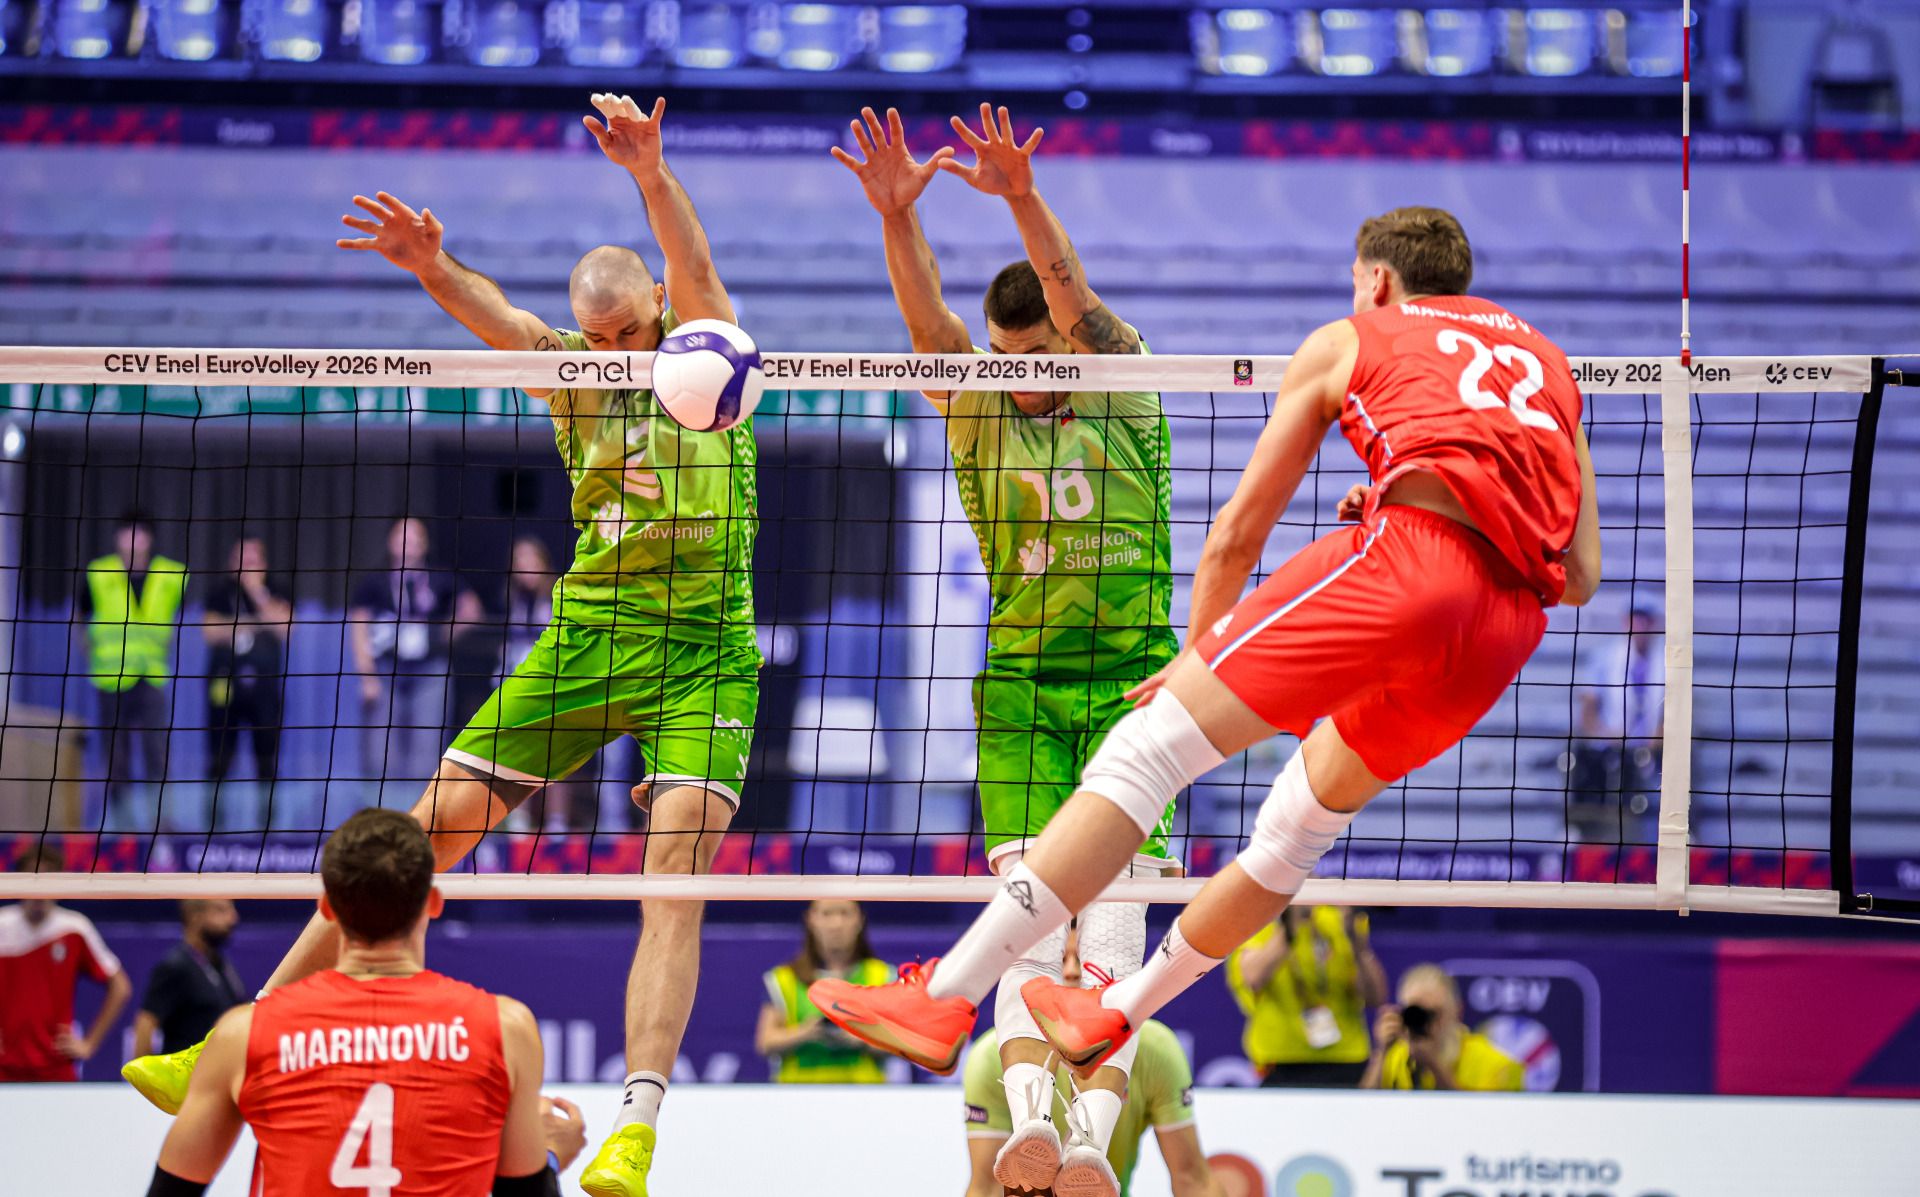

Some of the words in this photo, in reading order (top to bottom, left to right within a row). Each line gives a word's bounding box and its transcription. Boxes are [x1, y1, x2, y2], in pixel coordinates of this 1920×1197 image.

[104, 354, 151, 373] CEV
[155, 354, 200, 374] Enel
[206, 354, 321, 379] EuroVolley
[325, 355, 378, 375] 2026
[384, 356, 432, 375] Men
[557, 355, 634, 382] enel
[763, 358, 805, 378] CEV
[810, 358, 853, 378] Enel
[859, 358, 971, 384] EuroVolley
[976, 359, 1028, 379] 2026
[1034, 360, 1081, 380] Men
[1625, 363, 1662, 383] 202
[1793, 366, 1833, 380] CEV
[1436, 329, 1558, 431] 22
[1021, 457, 1095, 521] 18
[1062, 530, 1142, 553] Telekom
[1064, 546, 1142, 570] Slovenije
[279, 1016, 470, 1073] MARINOVIĆ
[329, 1082, 402, 1197] 4
[1466, 1154, 1622, 1185] turismo
